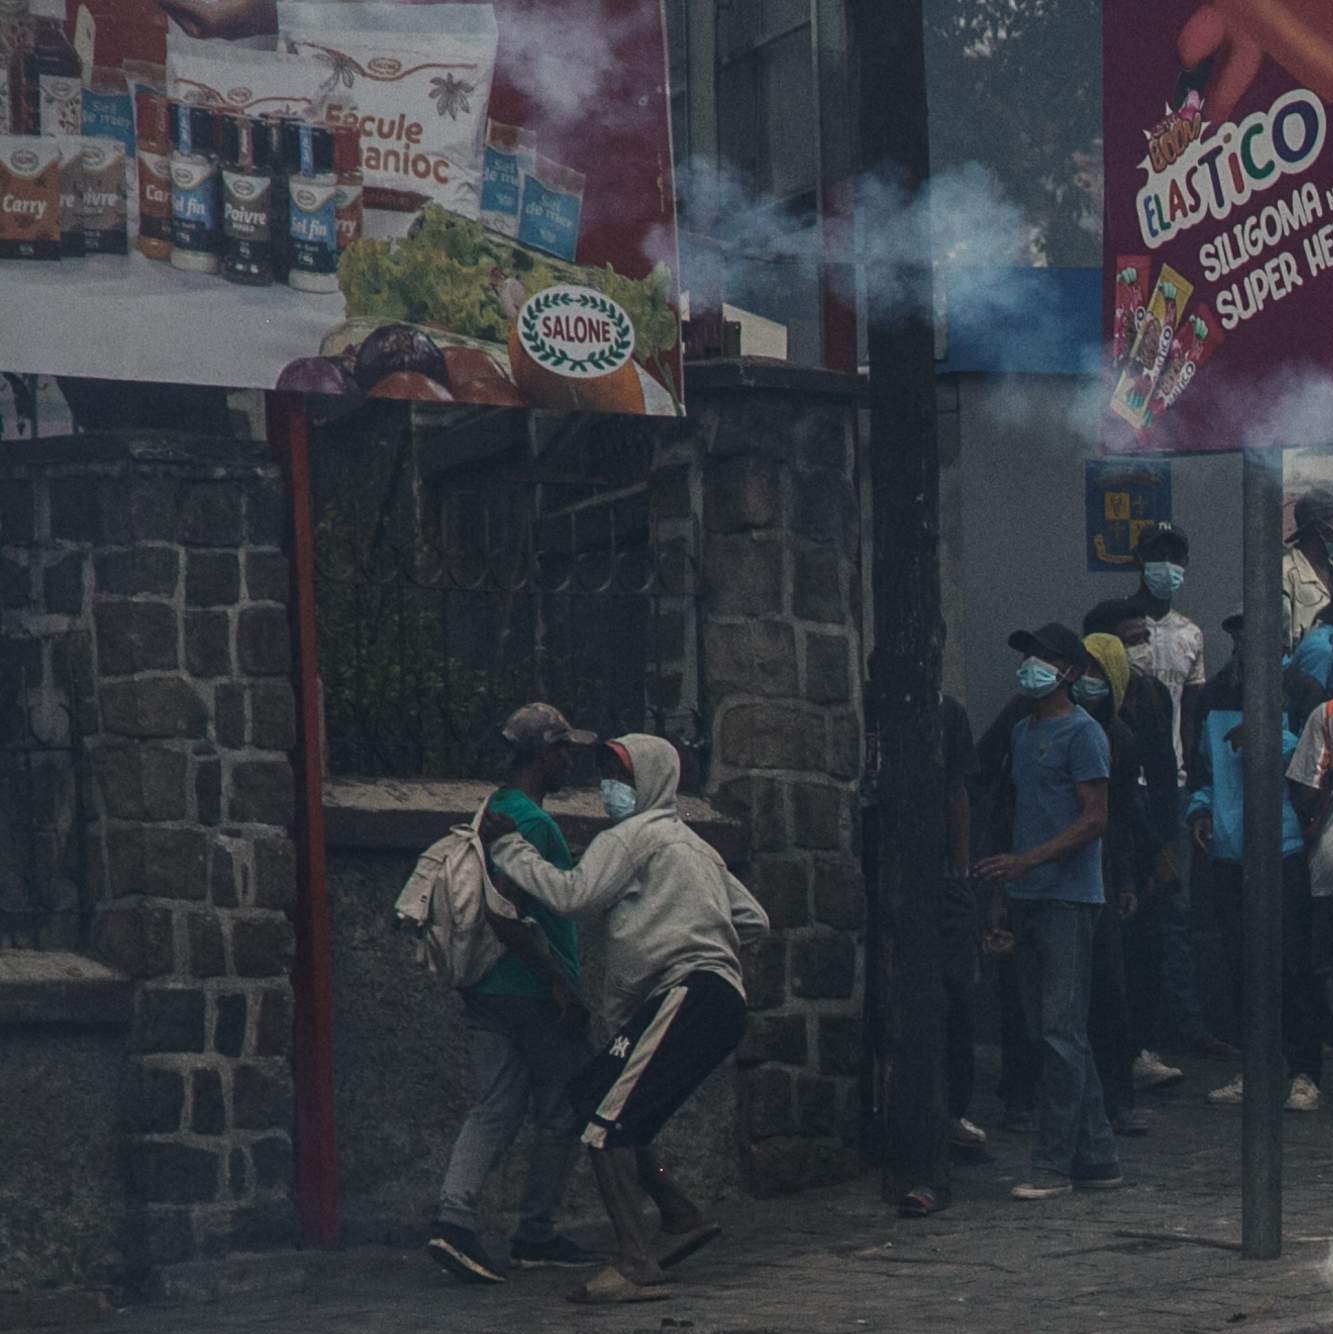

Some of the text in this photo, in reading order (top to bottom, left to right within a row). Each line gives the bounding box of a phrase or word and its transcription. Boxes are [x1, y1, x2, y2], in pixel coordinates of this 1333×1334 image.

[363, 143, 451, 185] anioc
[1, 194, 48, 220] Carry
[224, 202, 267, 226] Poivre
[525, 201, 573, 228] de mer
[309, 219, 328, 239] fin
[1199, 181, 1323, 282] SILIGOMA
[1216, 251, 1304, 330] SUPER
[541, 314, 611, 344] SALONE
